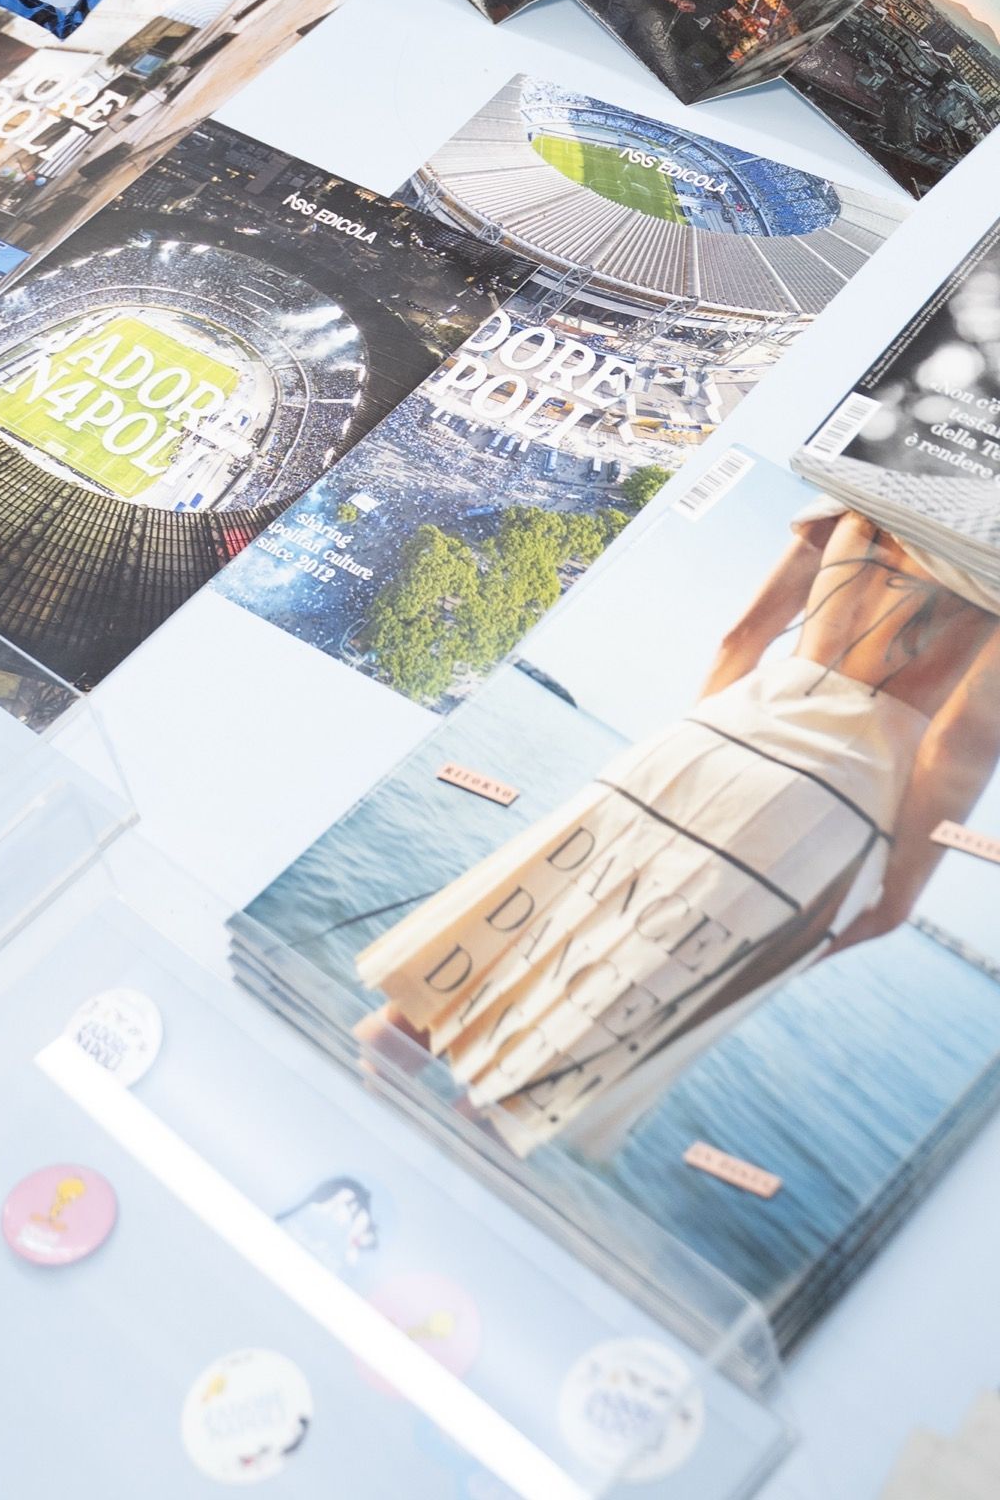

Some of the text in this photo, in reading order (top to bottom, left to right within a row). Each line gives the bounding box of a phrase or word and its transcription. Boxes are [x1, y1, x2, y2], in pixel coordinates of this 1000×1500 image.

[656, 160, 729, 195] EDICOLA
[314, 208, 378, 244] EDICOLA
[430, 353, 595, 450] POLI
[930, 422, 977, 450] della
[904, 432, 994, 479] è rendere
[297, 512, 355, 549] sharing
[256, 536, 337, 583] since 2012
[323, 549, 374, 581] culture
